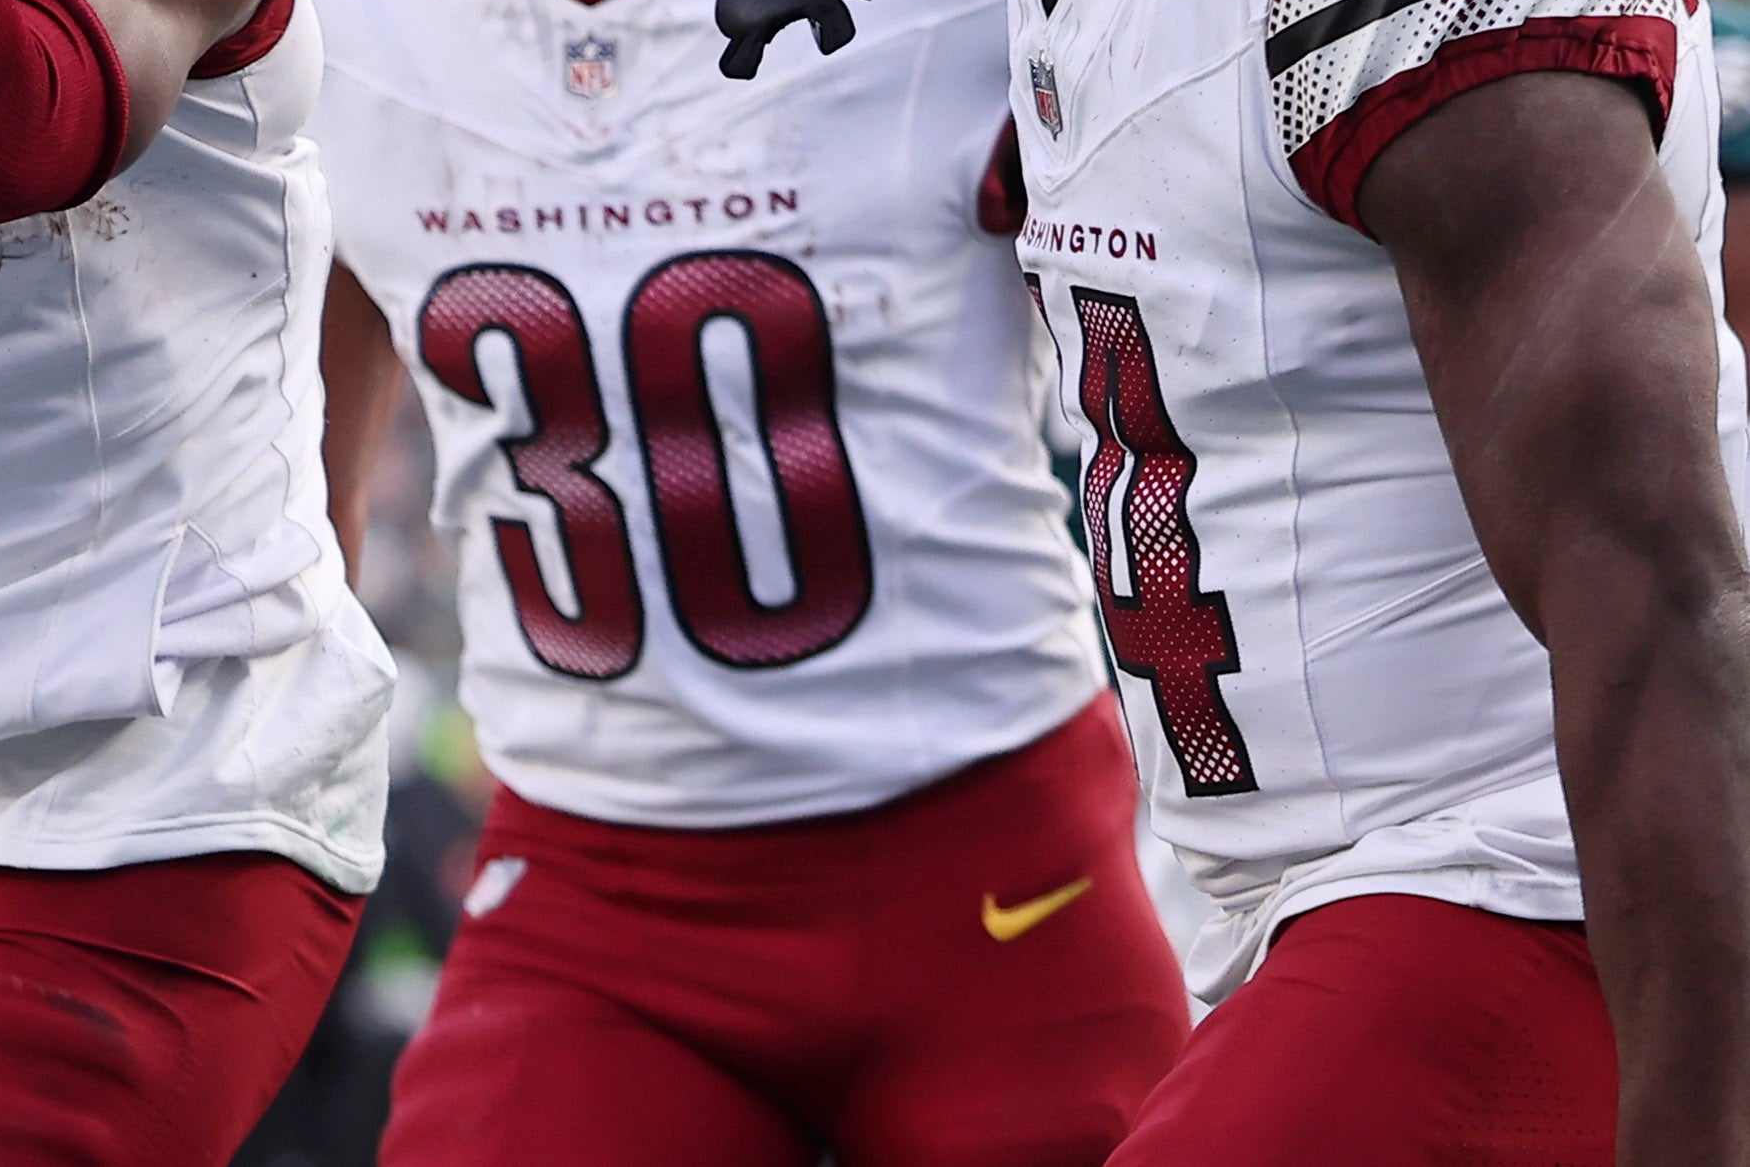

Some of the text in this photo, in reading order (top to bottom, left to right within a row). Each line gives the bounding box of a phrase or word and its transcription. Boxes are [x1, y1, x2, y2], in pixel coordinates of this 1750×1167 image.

[417, 188, 799, 234] WASHINGTON
[1021, 214, 1157, 261] ASHINGTON
[416, 249, 872, 682] 30
[1022, 272, 1260, 798] 4
